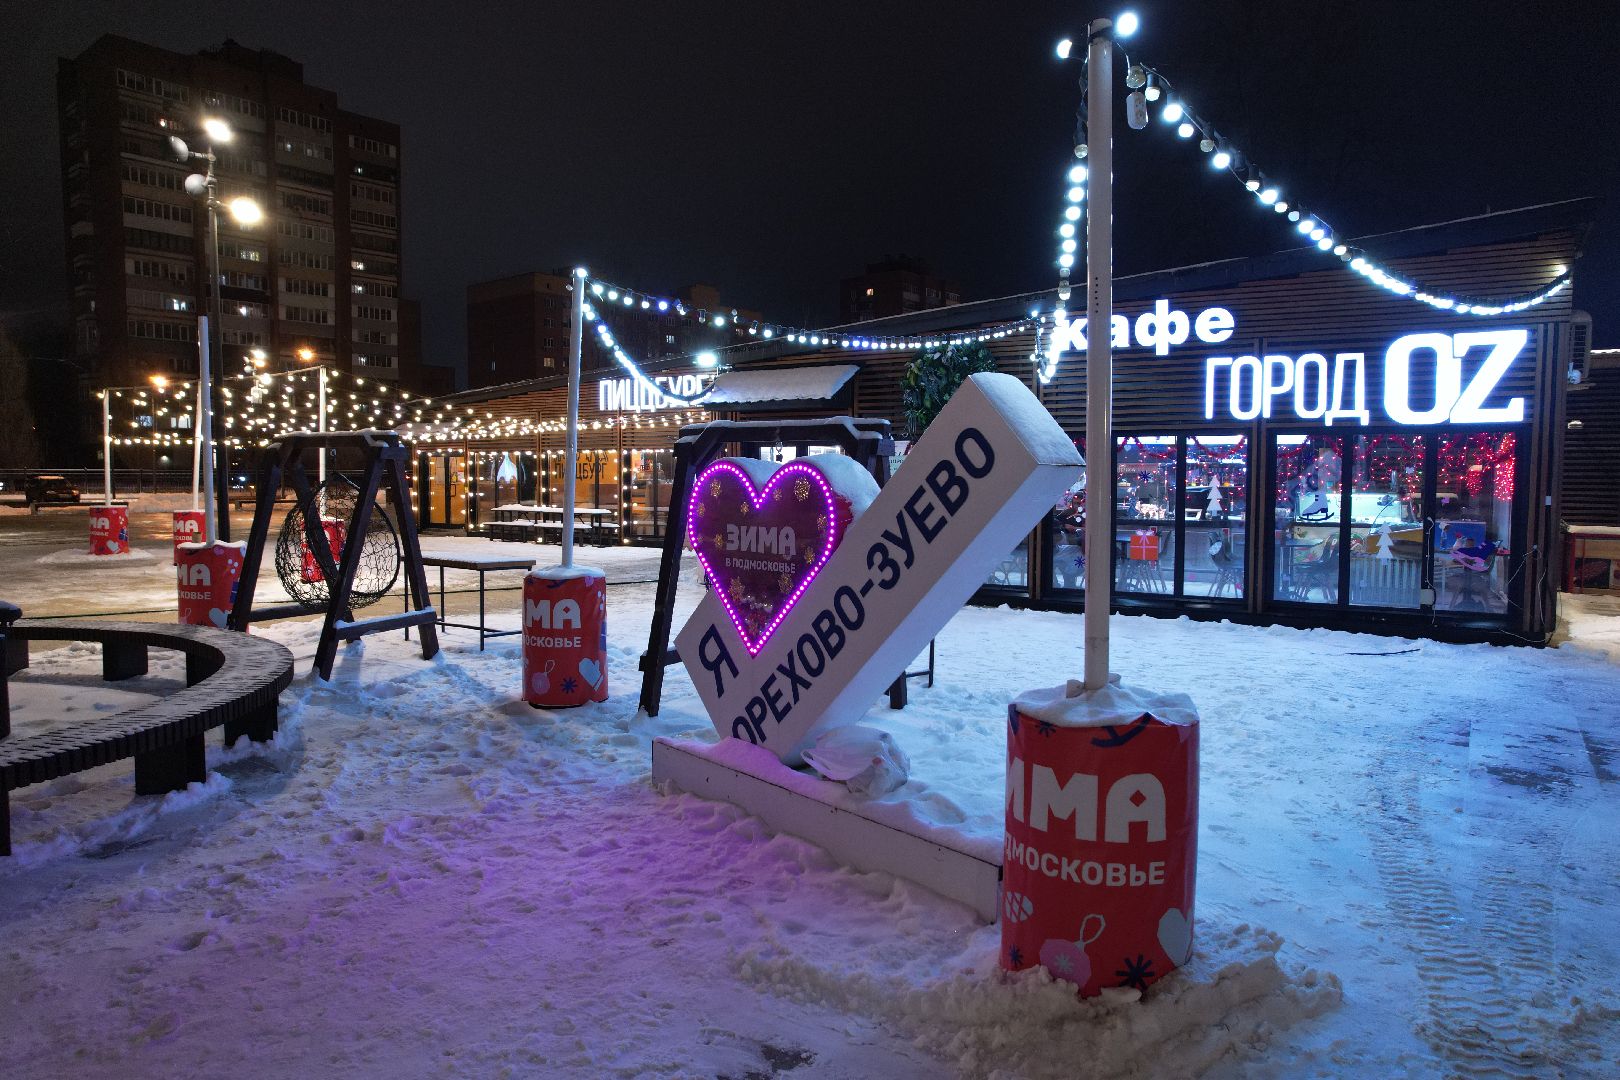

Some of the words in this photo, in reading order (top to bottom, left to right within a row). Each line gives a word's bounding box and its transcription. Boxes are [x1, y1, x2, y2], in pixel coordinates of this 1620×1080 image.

[1204, 352, 1370, 426] ГОРОД
[1383, 329, 1529, 425] OZ
[554, 462, 608, 481] ПЦБУГ
[725, 557, 732, 567] В
[732, 557, 796, 574] ПОДМОСКОВЬЕ
[726, 523, 797, 556] ЗИМА
[731, 427, 996, 745] ОРЕХОВО-ЗУЕВО
[698, 624, 740, 699] Я
